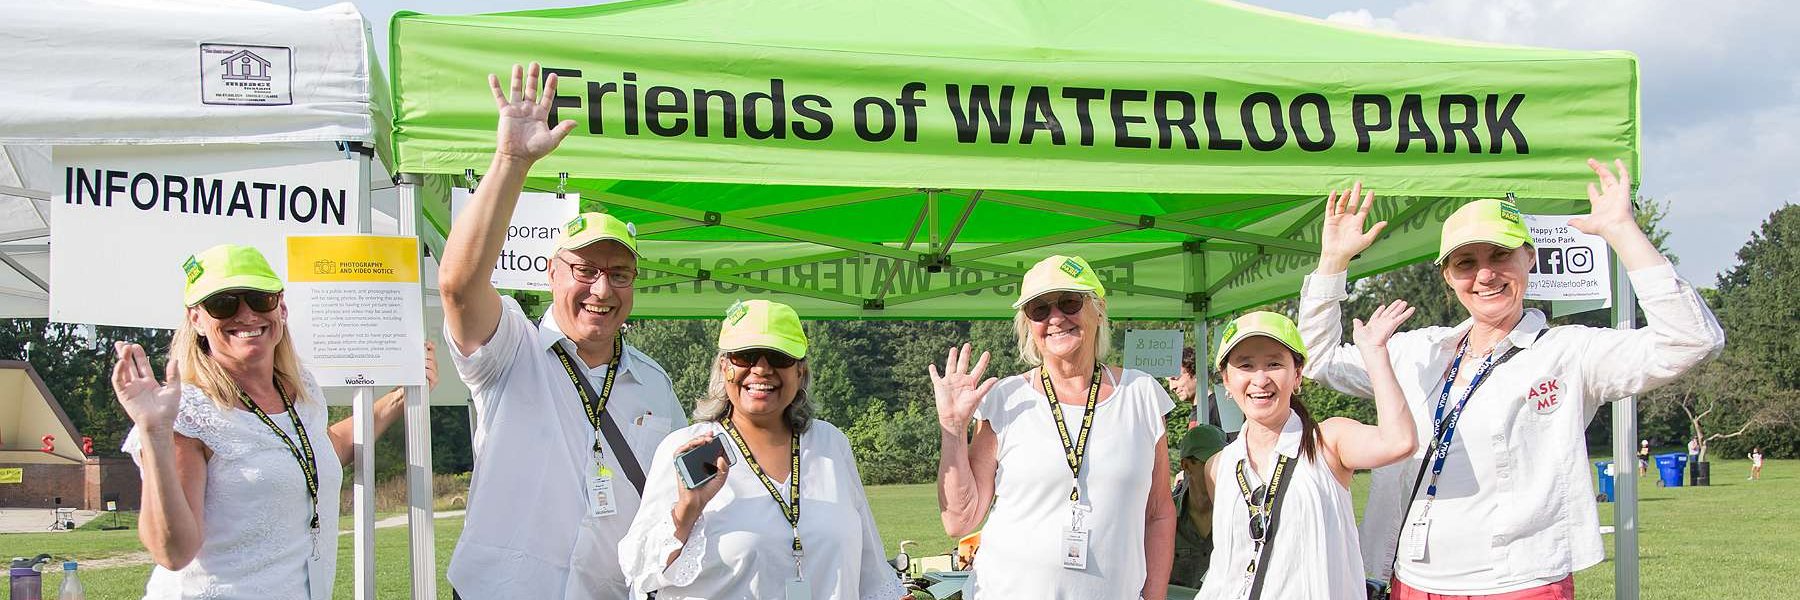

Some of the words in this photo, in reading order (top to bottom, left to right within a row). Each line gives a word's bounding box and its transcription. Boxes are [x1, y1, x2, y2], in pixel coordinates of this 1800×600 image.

[541, 67, 833, 141] Friends
[853, 82, 926, 143] of
[945, 83, 1336, 152] WATERLOO
[1356, 93, 1530, 154] PARK
[65, 166, 346, 225] INFORMATION
[1530, 227, 1553, 235] Happy
[1528, 379, 1559, 400] ASK
[1537, 394, 1558, 410] ME
